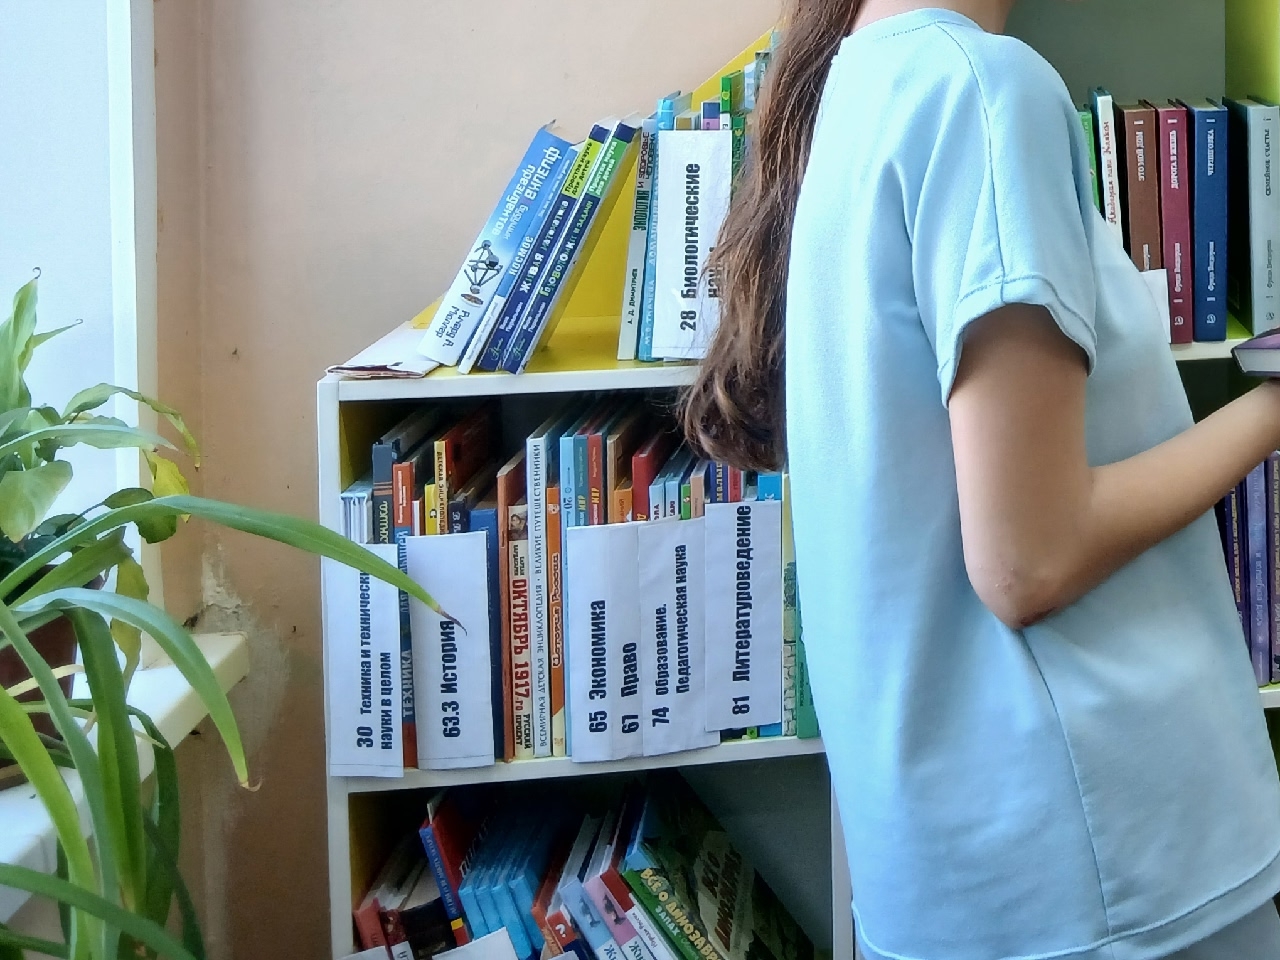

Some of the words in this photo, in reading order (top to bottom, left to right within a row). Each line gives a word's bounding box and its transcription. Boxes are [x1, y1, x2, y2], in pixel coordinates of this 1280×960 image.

[681, 164, 699, 298] Биологические
[680, 311, 696, 330] 28
[675, 545, 687, 583] наука
[732, 505, 753, 681] Литературоведение
[513, 579, 528, 655] ОКТЯБРЬ
[361, 650, 371, 658] и
[439, 621, 458, 693] История
[589, 600, 606, 700] Экономика
[655, 603, 669, 695] Образование.
[675, 586, 691, 693] Педагогическая
[360, 661, 372, 714] Техника
[378, 652, 391, 694] целом
[621, 642, 639, 697] Право
[381, 698, 391, 706] в
[442, 701, 460, 737] 63.3
[652, 707, 669, 727] 74
[732, 695, 749, 715] 81
[357, 727, 373, 748] 30
[379, 710, 393, 749] науки
[589, 711, 607, 733] 65
[622, 715, 638, 733] 67
